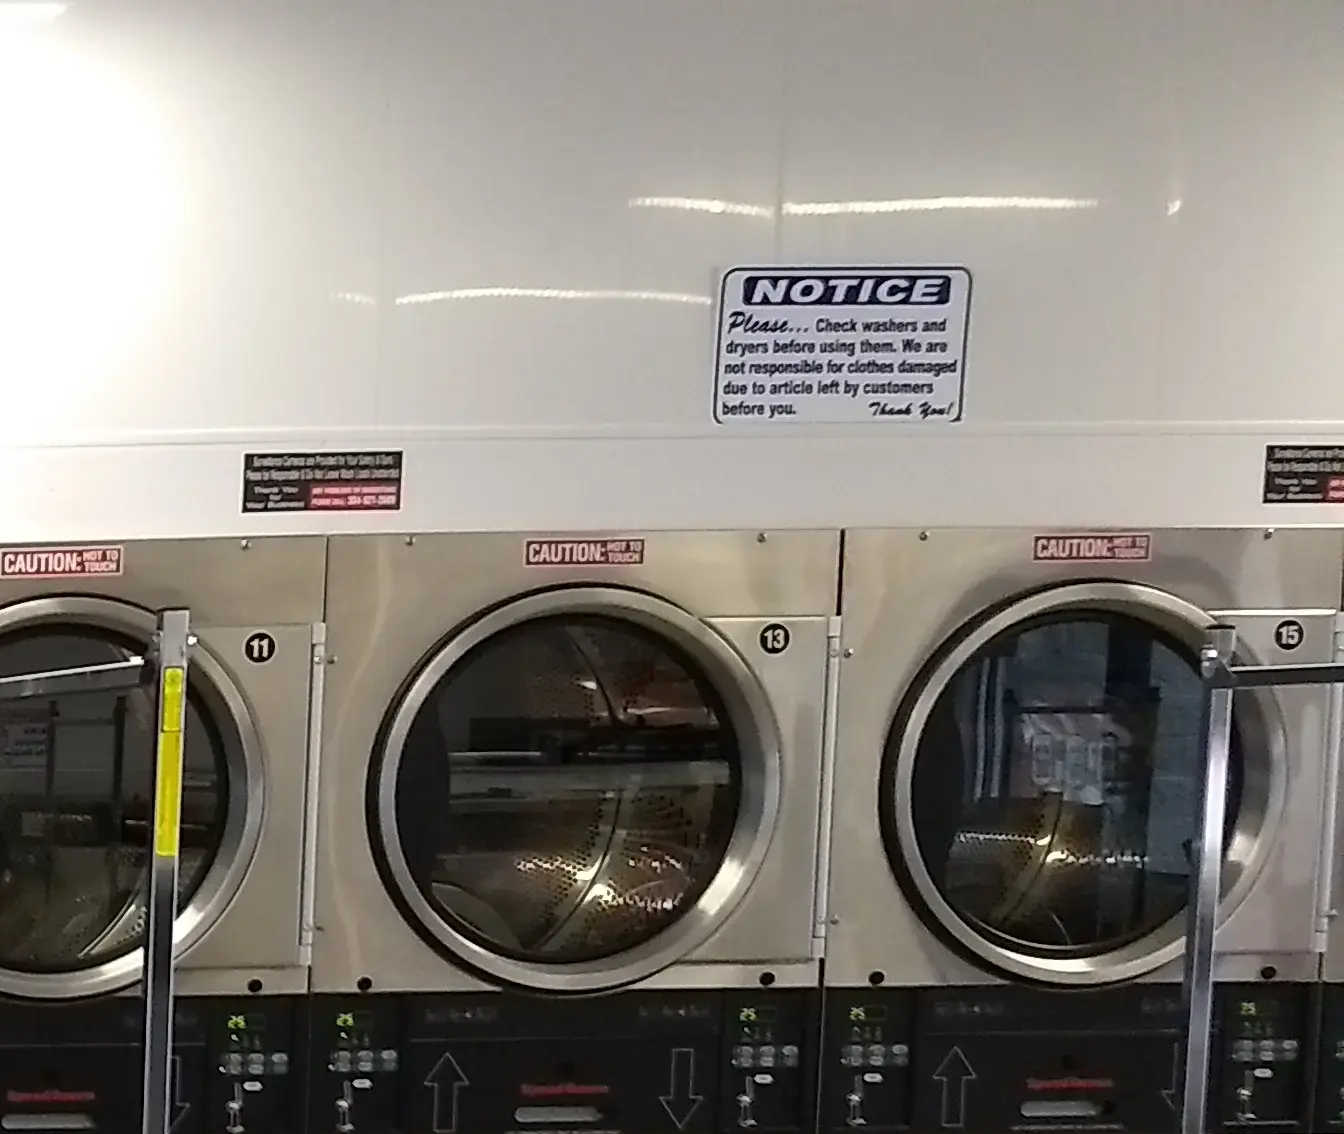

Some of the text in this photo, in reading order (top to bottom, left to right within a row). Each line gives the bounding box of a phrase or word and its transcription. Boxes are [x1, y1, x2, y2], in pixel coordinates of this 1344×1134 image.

[752, 278, 946, 303] NOTICE
[728, 311, 946, 334] Please... Check washers and
[726, 339, 947, 357] dryers before using them. We are
[725, 360, 957, 377] not responsible for clothes damaged
[723, 380, 933, 398] due to article left by customers
[722, 402, 797, 419] before you.
[869, 402, 953, 419] Thank You!
[529, 542, 605, 562] CAUTION:
[1036, 538, 1112, 557] CAUTION:
[4, 552, 81, 572] CAUTION:
[763, 629, 784, 649] 13
[1279, 625, 1299, 645] 15
[250, 639, 268, 658] 11
